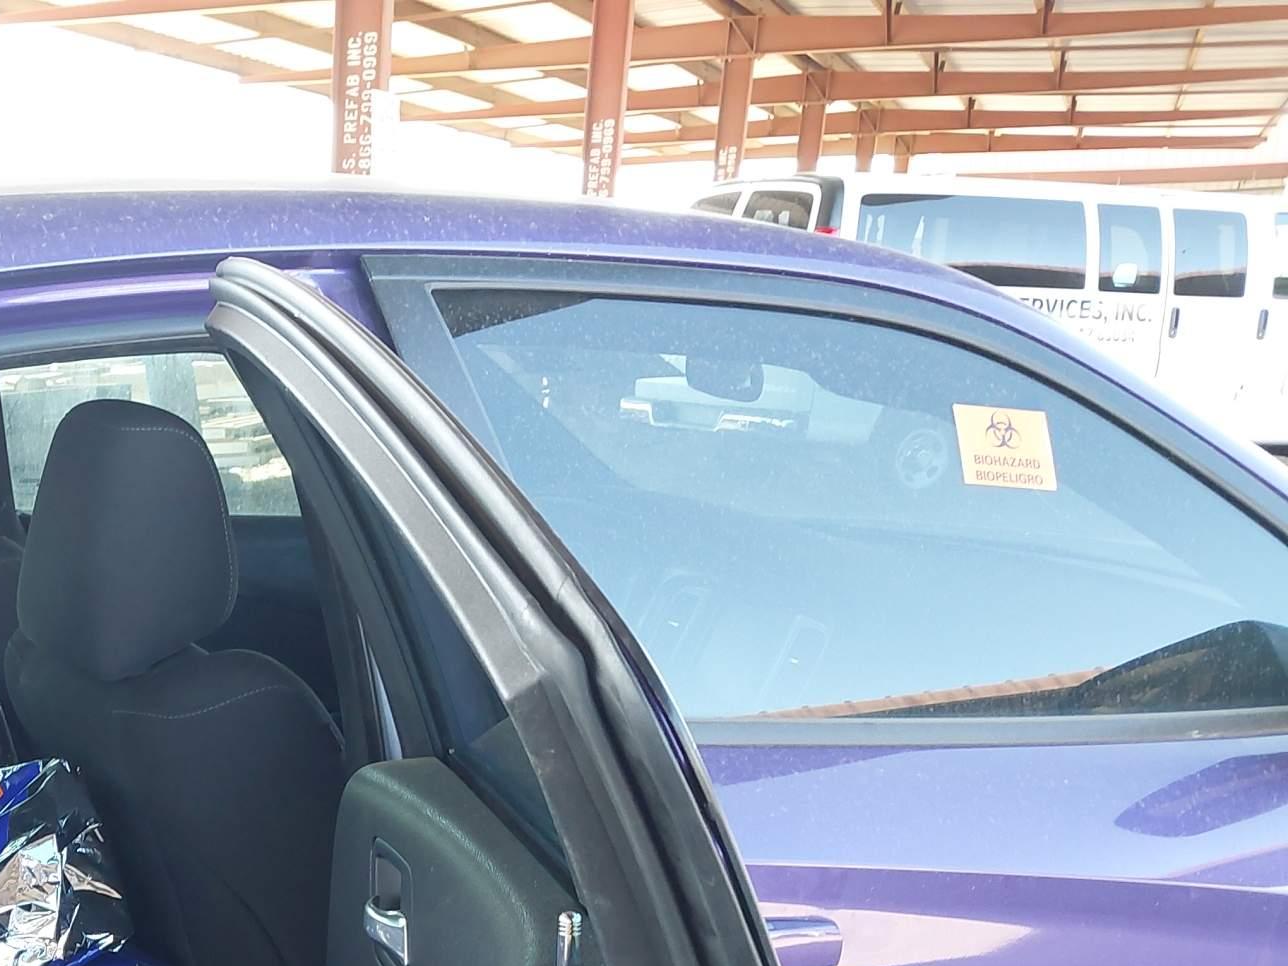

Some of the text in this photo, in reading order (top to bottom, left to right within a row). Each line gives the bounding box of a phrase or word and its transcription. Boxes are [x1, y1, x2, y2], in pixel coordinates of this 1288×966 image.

[346, 31, 362, 67] INC.
[343, 74, 360, 144] PREFAB
[1114, 302, 1153, 323] INC.
[973, 454, 1041, 469] BIOHAZARD
[976, 470, 1044, 487] BIOPELIGRO
